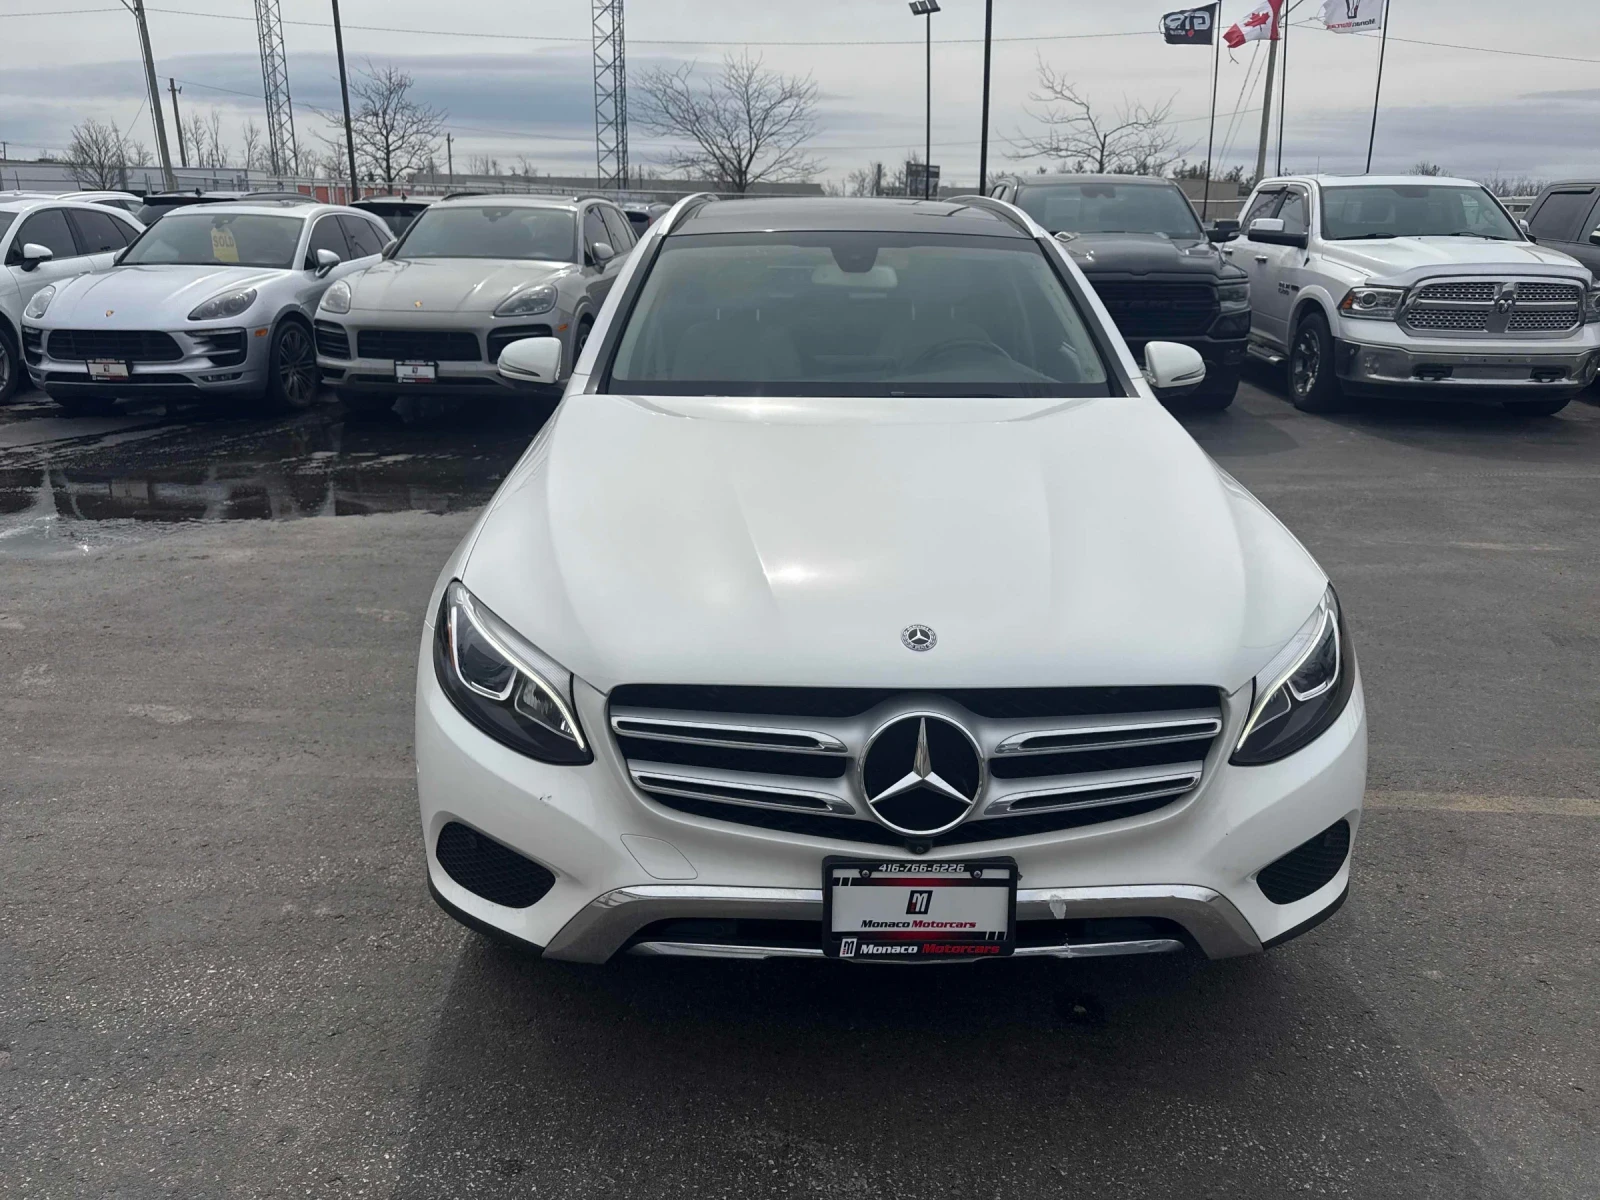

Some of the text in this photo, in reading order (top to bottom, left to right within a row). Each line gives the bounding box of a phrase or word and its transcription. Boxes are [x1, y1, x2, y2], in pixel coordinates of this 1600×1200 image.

[213, 235, 235, 248] SOLD
[878, 863, 965, 873] 416-766-6226
[861, 919, 976, 928] Monaco Motorcars
[860, 943, 1001, 954] Monaco Motorcars
